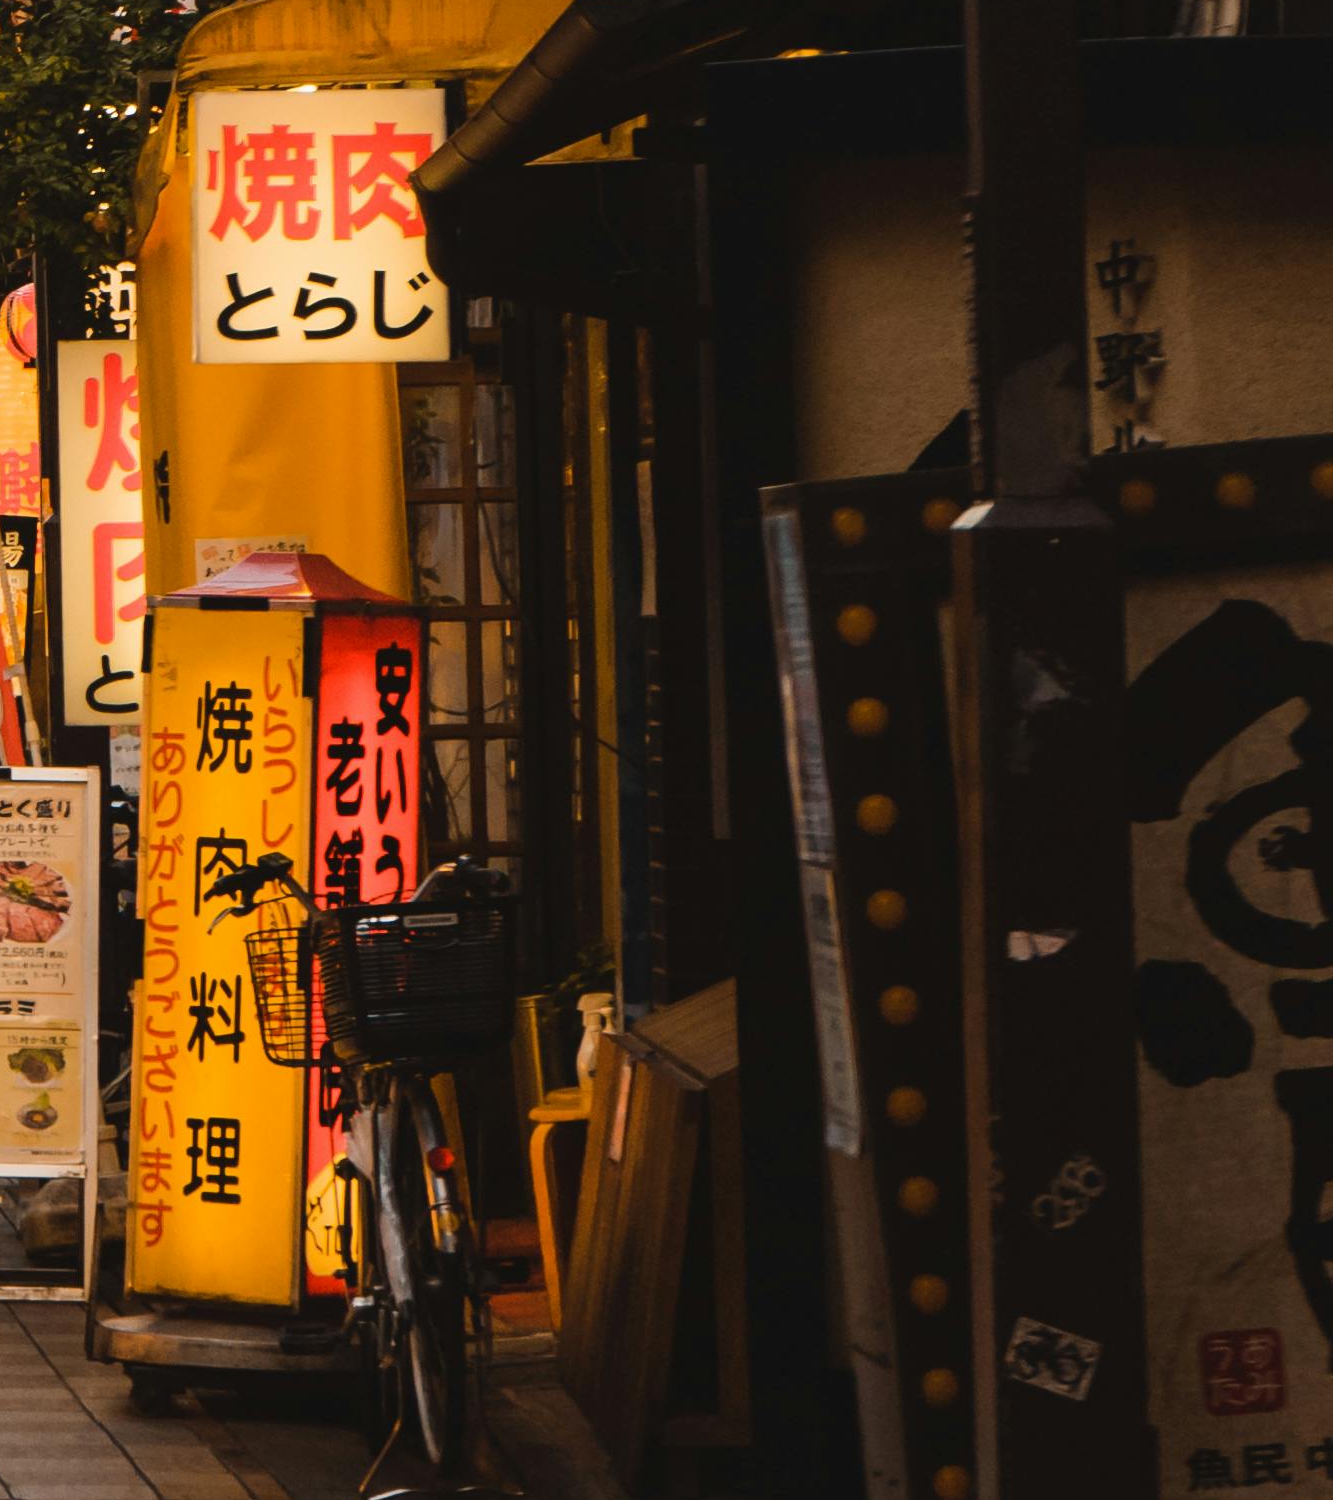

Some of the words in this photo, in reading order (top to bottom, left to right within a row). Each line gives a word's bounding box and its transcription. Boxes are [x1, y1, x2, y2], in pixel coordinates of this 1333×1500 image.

[206, 123, 433, 244] 焼肉
[215, 269, 434, 342] とらじ
[136, 726, 187, 1248] ありがとうございます
